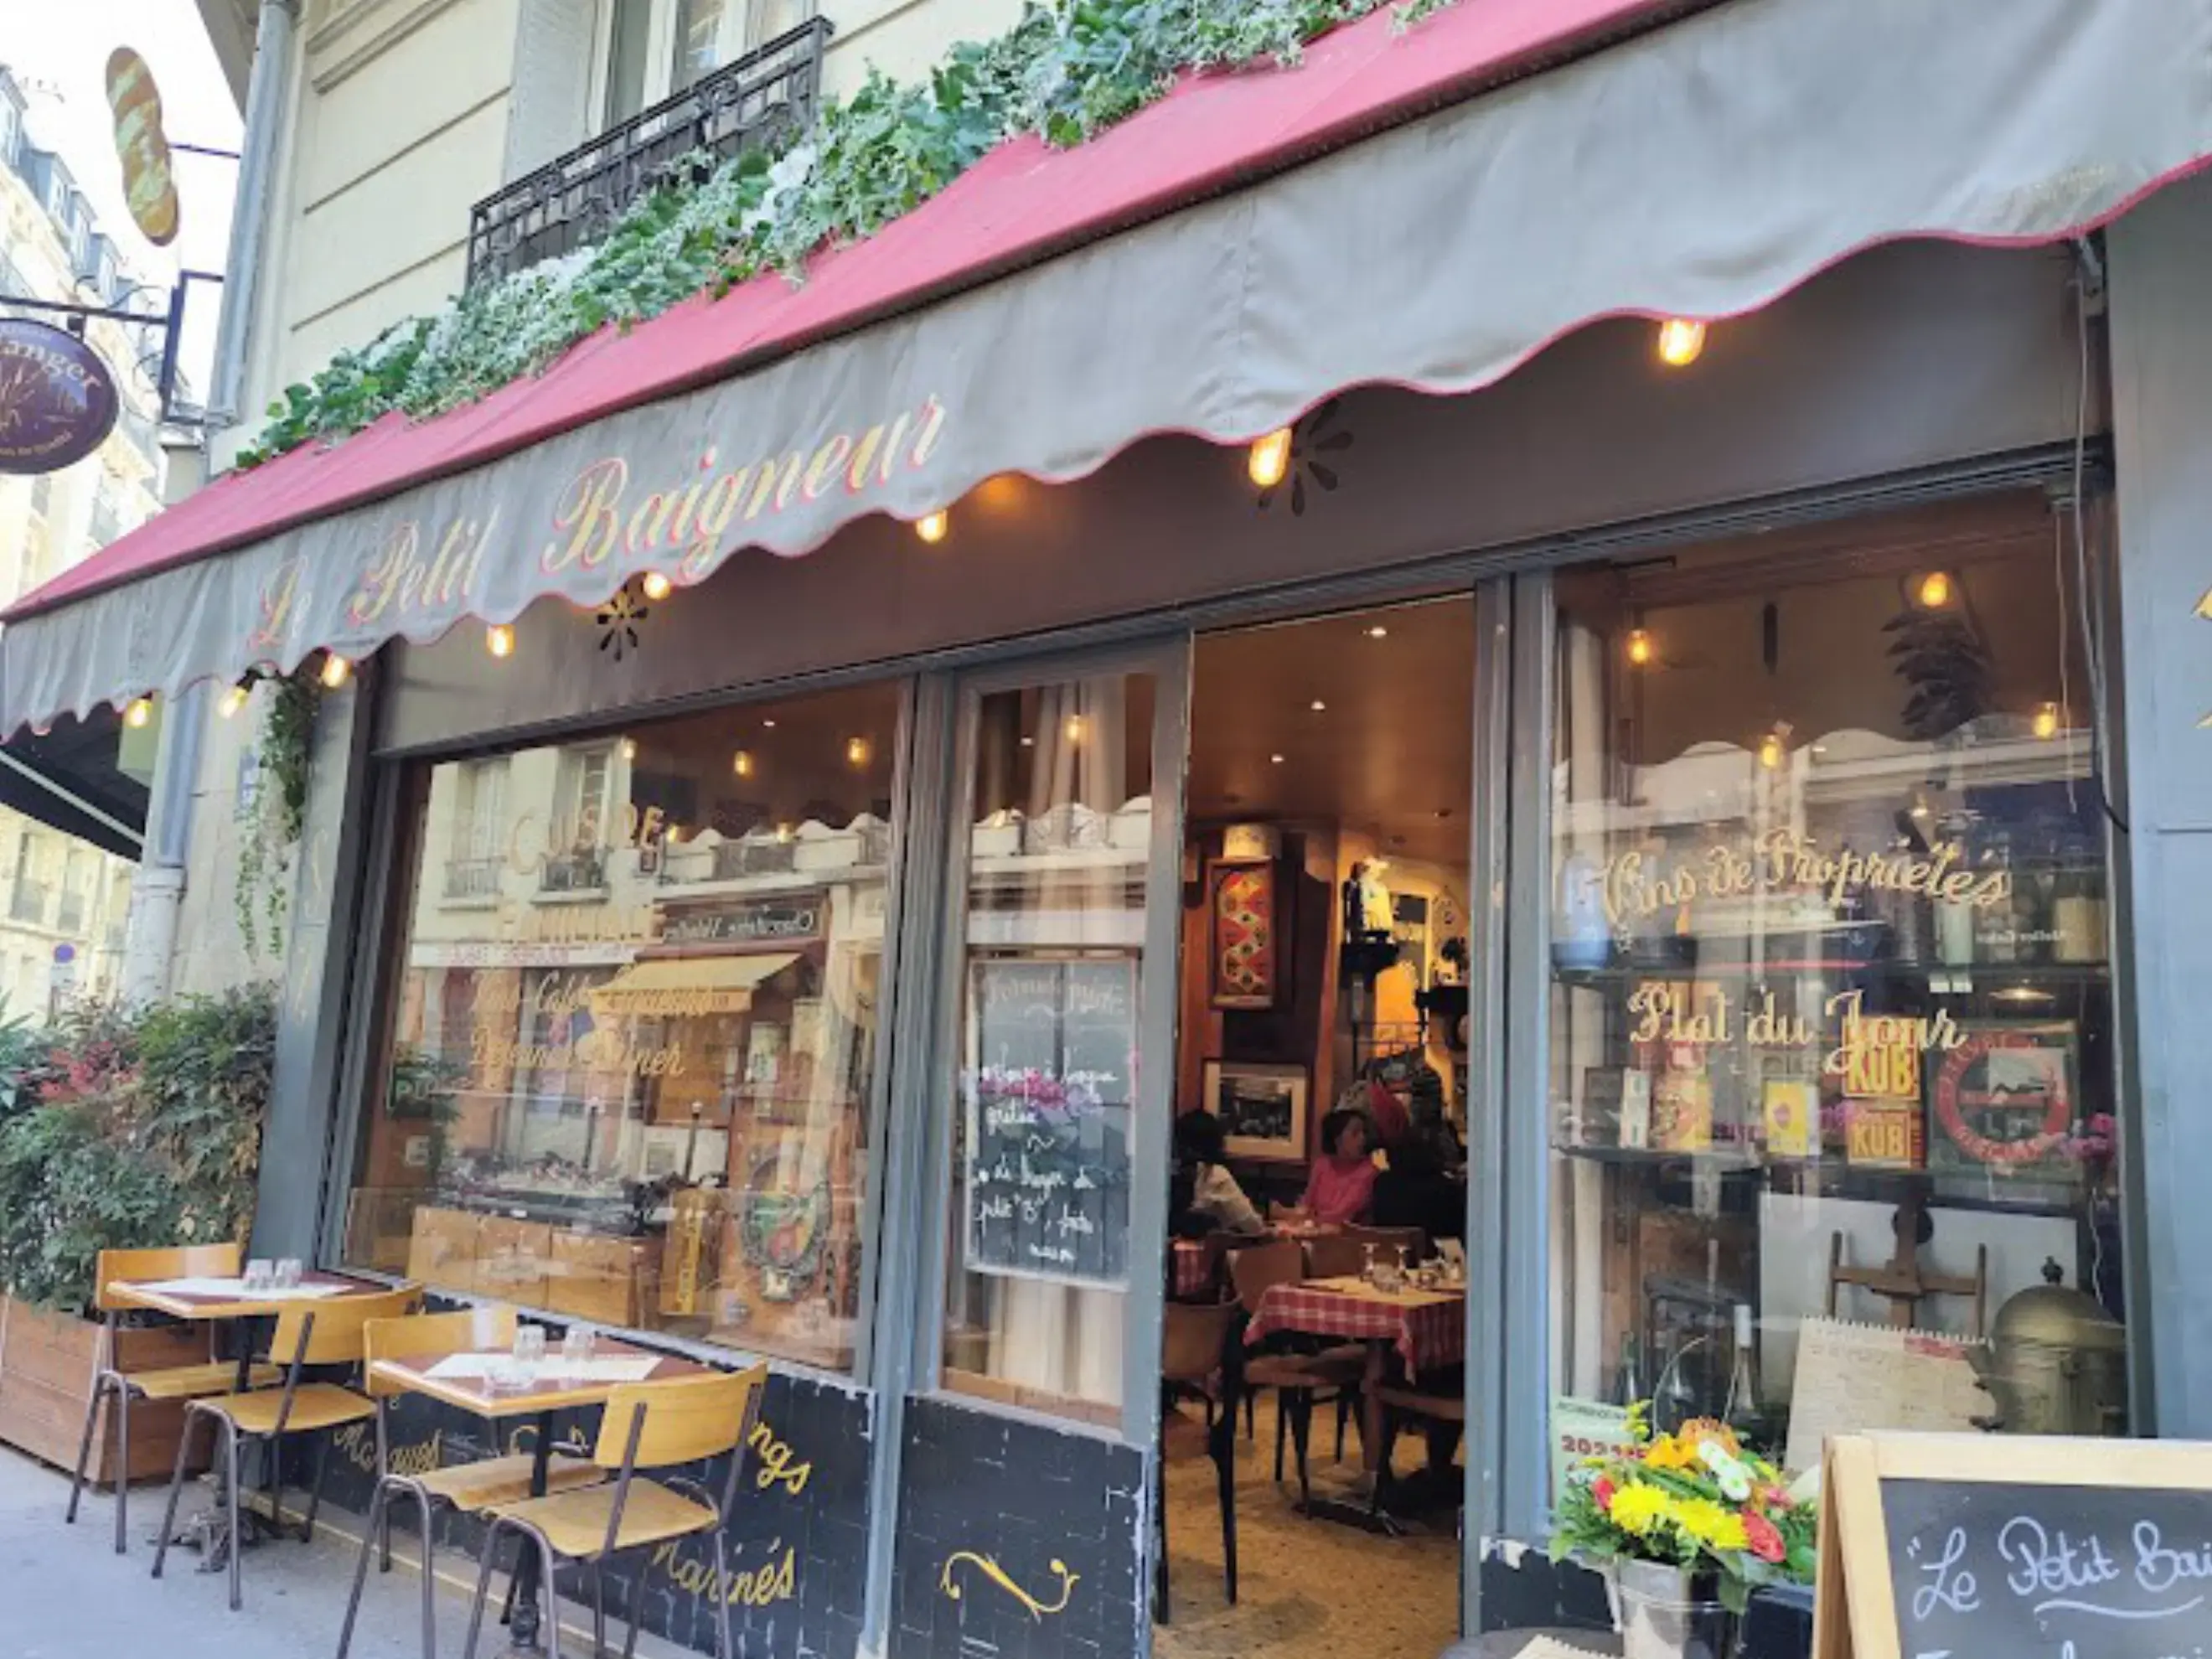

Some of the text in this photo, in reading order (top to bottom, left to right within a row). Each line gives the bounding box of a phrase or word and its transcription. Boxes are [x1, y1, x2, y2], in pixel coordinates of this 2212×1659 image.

[346, 504, 501, 630] Petit
[541, 394, 945, 586] Baigneur
[1628, 990, 1734, 1043] Plat
[1746, 993, 1814, 1046] du
[1824, 989, 1972, 1074] Jour
[1848, 1046, 1915, 1094] KUB
[1852, 1120, 1905, 1158] KUB
[651, 1535, 795, 1607] arnés
[1998, 1516, 2121, 1596] Petit
